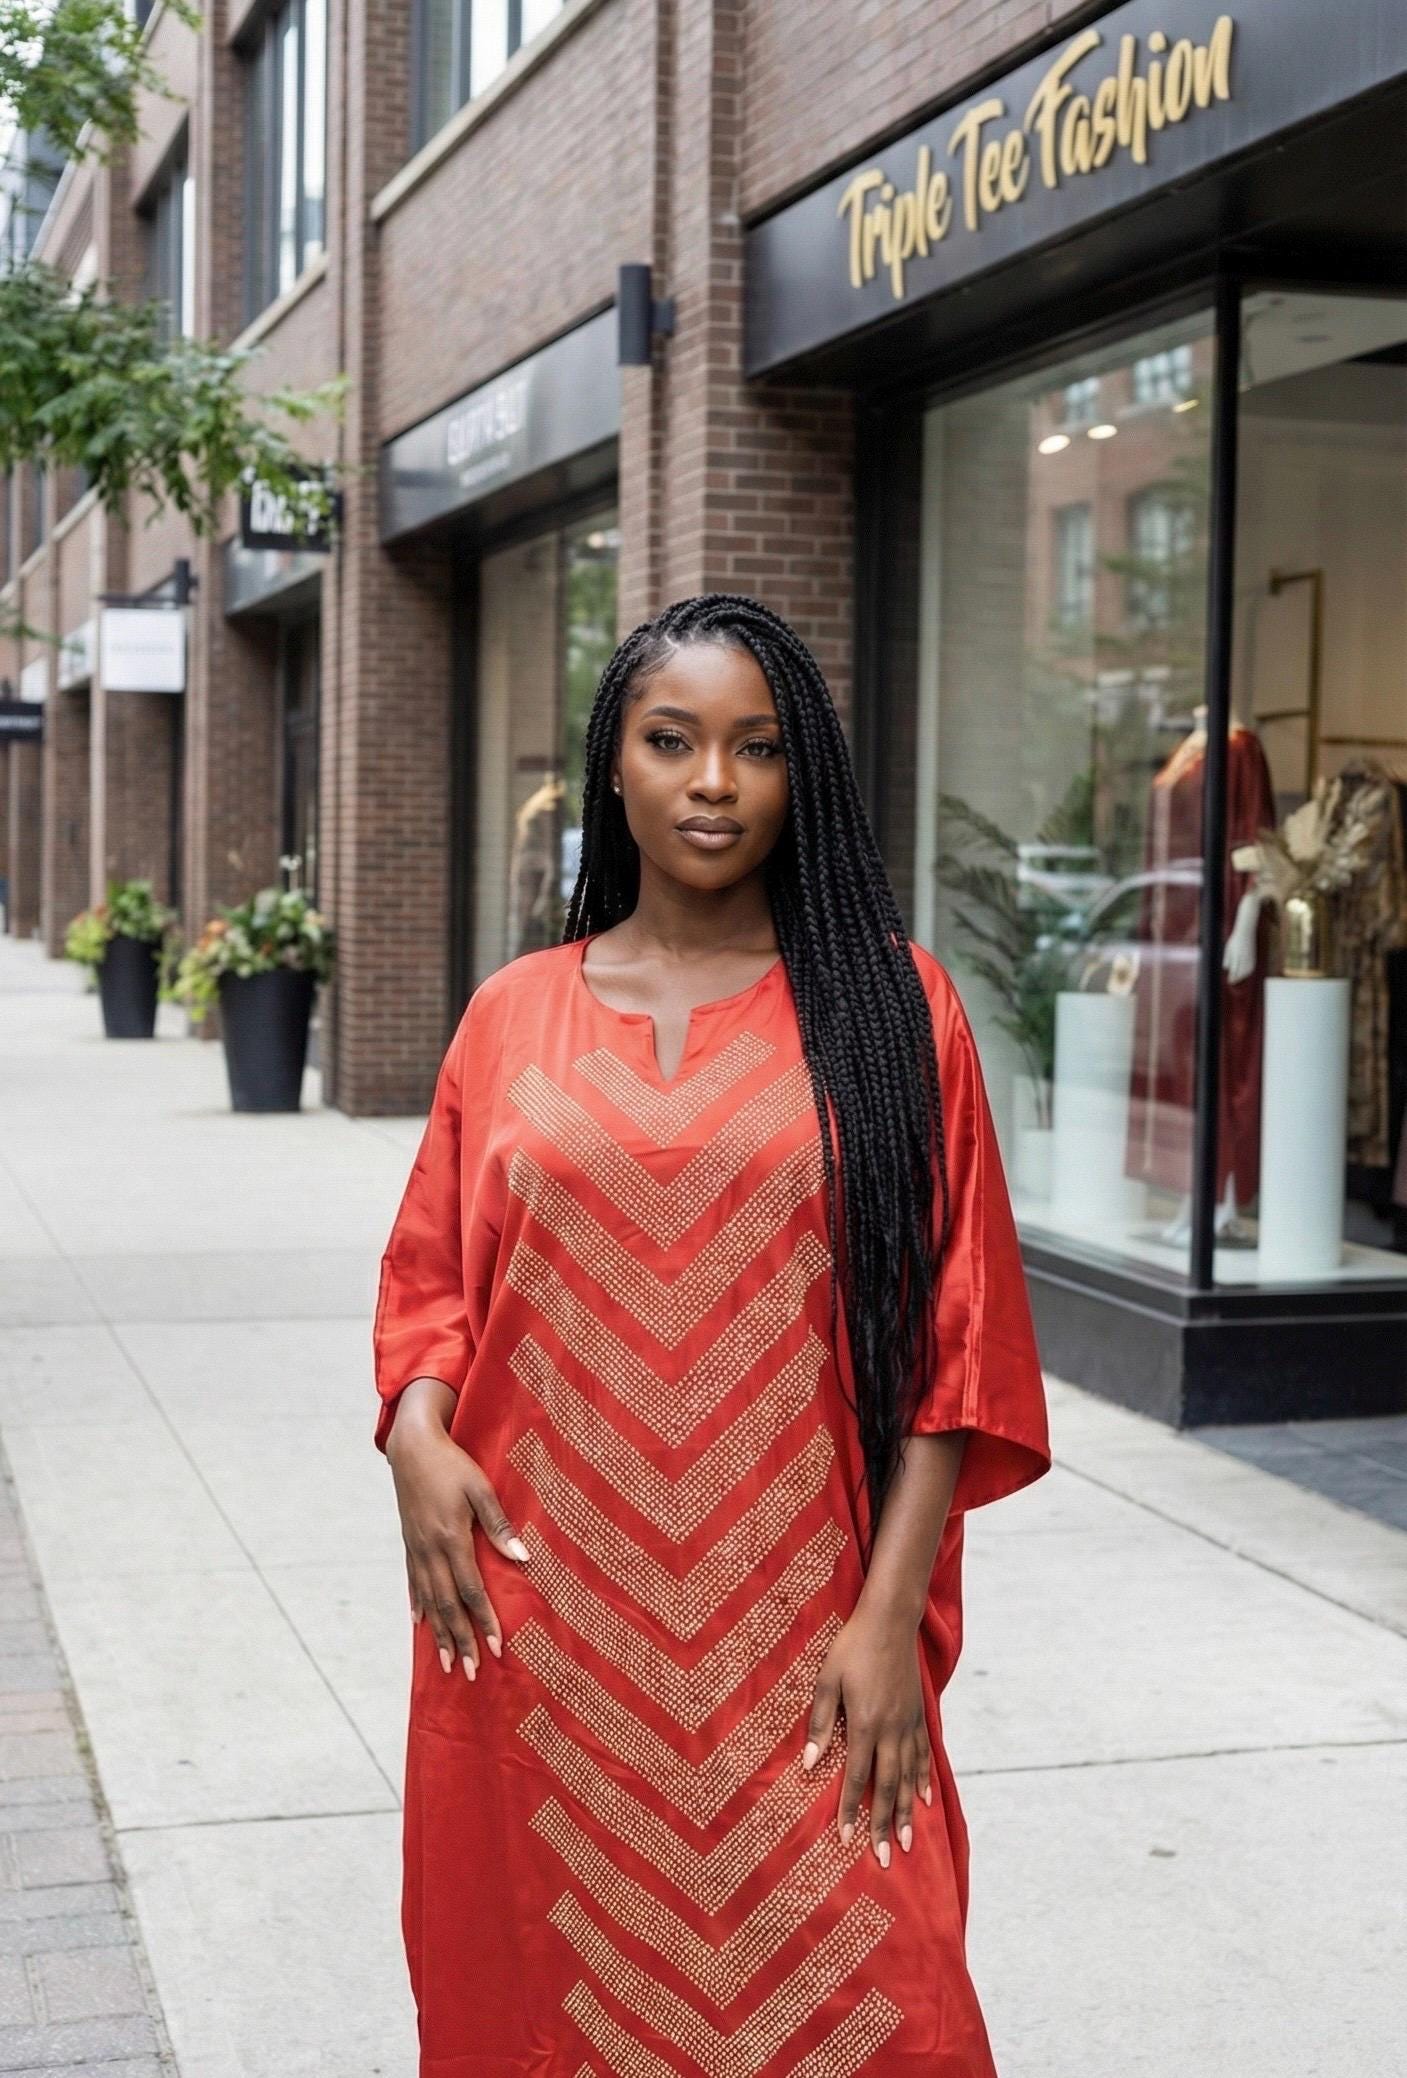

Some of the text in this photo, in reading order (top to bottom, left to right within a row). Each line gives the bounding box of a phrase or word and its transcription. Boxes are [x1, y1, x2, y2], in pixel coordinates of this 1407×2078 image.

[839, 16, 1232, 298] Triple Tee Fashion
